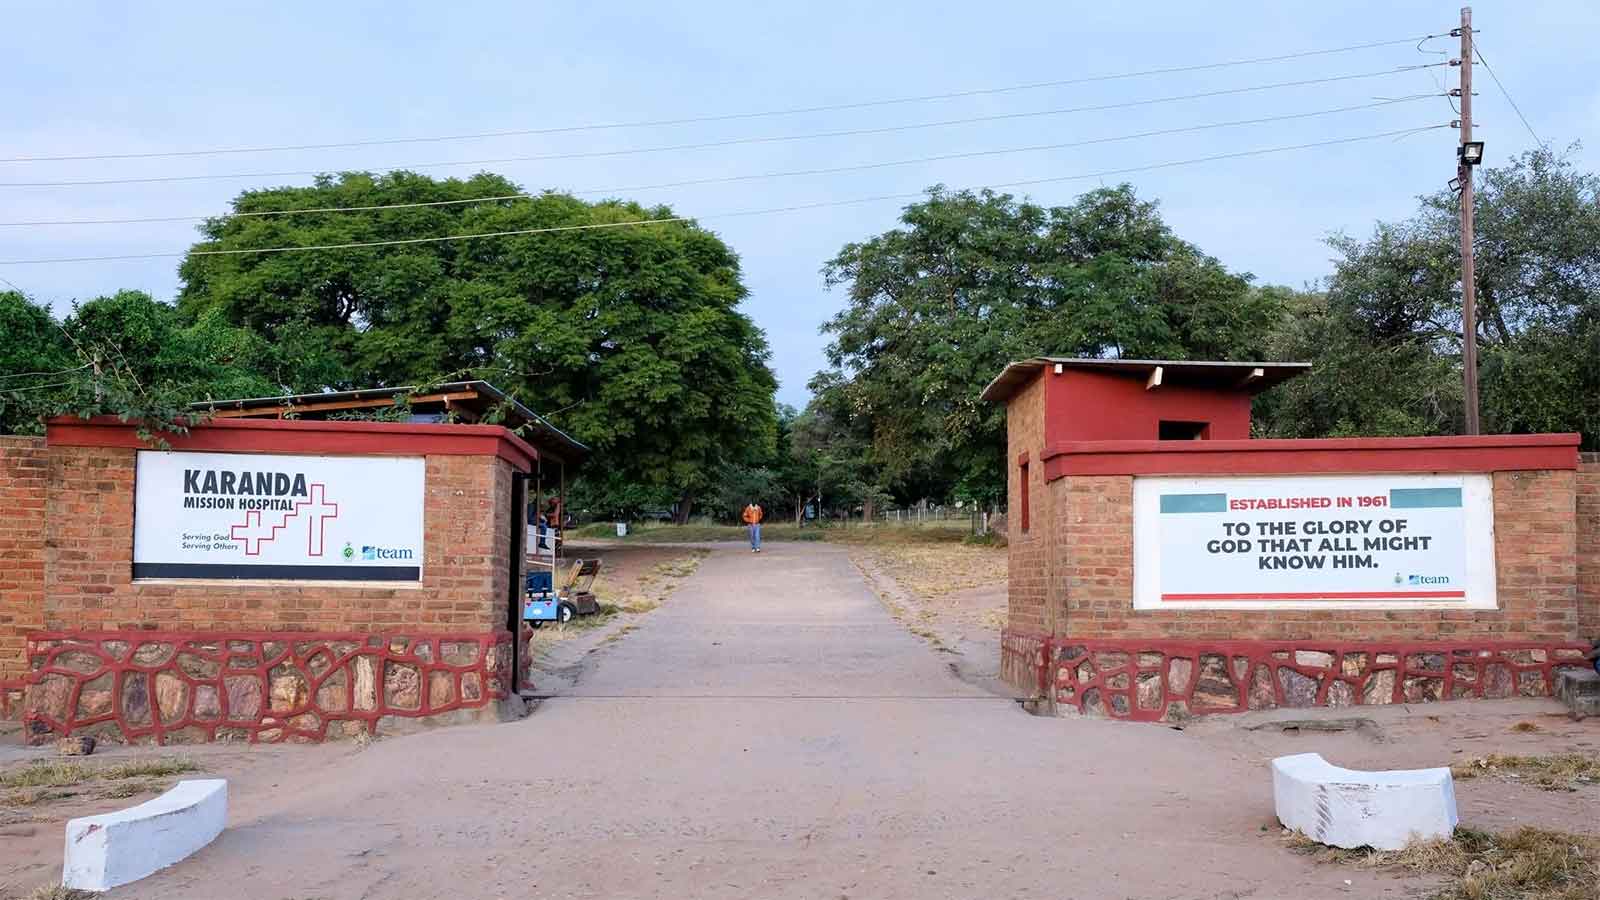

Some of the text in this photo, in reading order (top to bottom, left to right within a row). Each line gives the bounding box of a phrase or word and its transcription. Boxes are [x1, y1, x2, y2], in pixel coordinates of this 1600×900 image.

[183, 469, 308, 497] KARANDA
[183, 496, 294, 512] MISSION HOSPITAL
[1229, 496, 1388, 510] ESTABLISHED IN 1961
[1222, 518, 1408, 537] TO THE GLORY OF
[181, 533, 230, 542] Serving God
[1206, 535, 1432, 554] GOD THAT ALL MIGHT
[181, 542, 239, 551] Serving Others
[376, 547, 413, 560] team
[1257, 553, 1380, 570] KNOW HIM.
[1420, 575, 1449, 585] team
